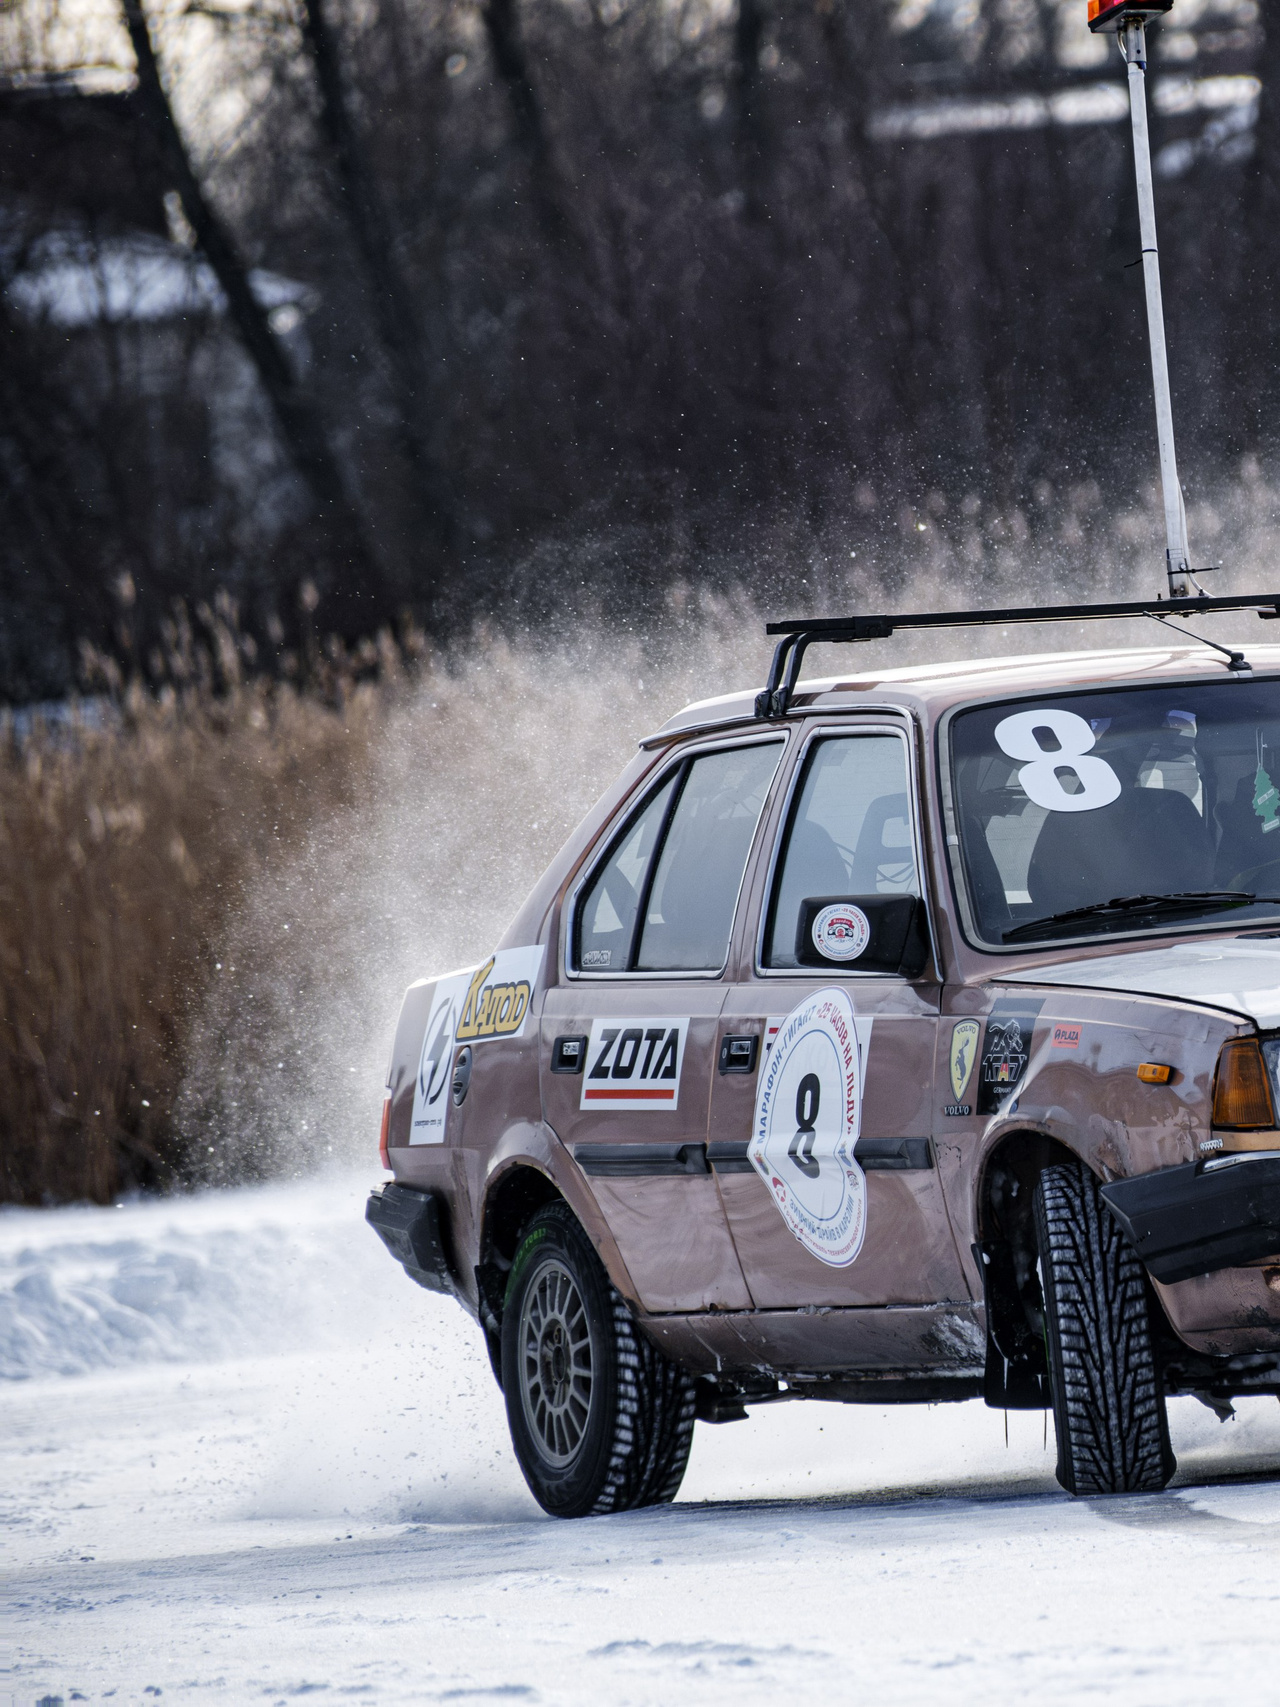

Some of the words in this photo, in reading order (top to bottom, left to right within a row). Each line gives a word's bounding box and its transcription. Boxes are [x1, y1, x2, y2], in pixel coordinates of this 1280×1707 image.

[994, 709, 1122, 812] 8
[455, 956, 531, 1042] KATOD
[957, 1025, 976, 1035] VOLVO
[588, 1028, 680, 1080] ZOTA
[830, 1005, 848, 1046] ЧАСОВ
[843, 1042, 852, 1070] НА
[787, 1073, 820, 1179] 8
[944, 1105, 970, 1115] VOLVO
